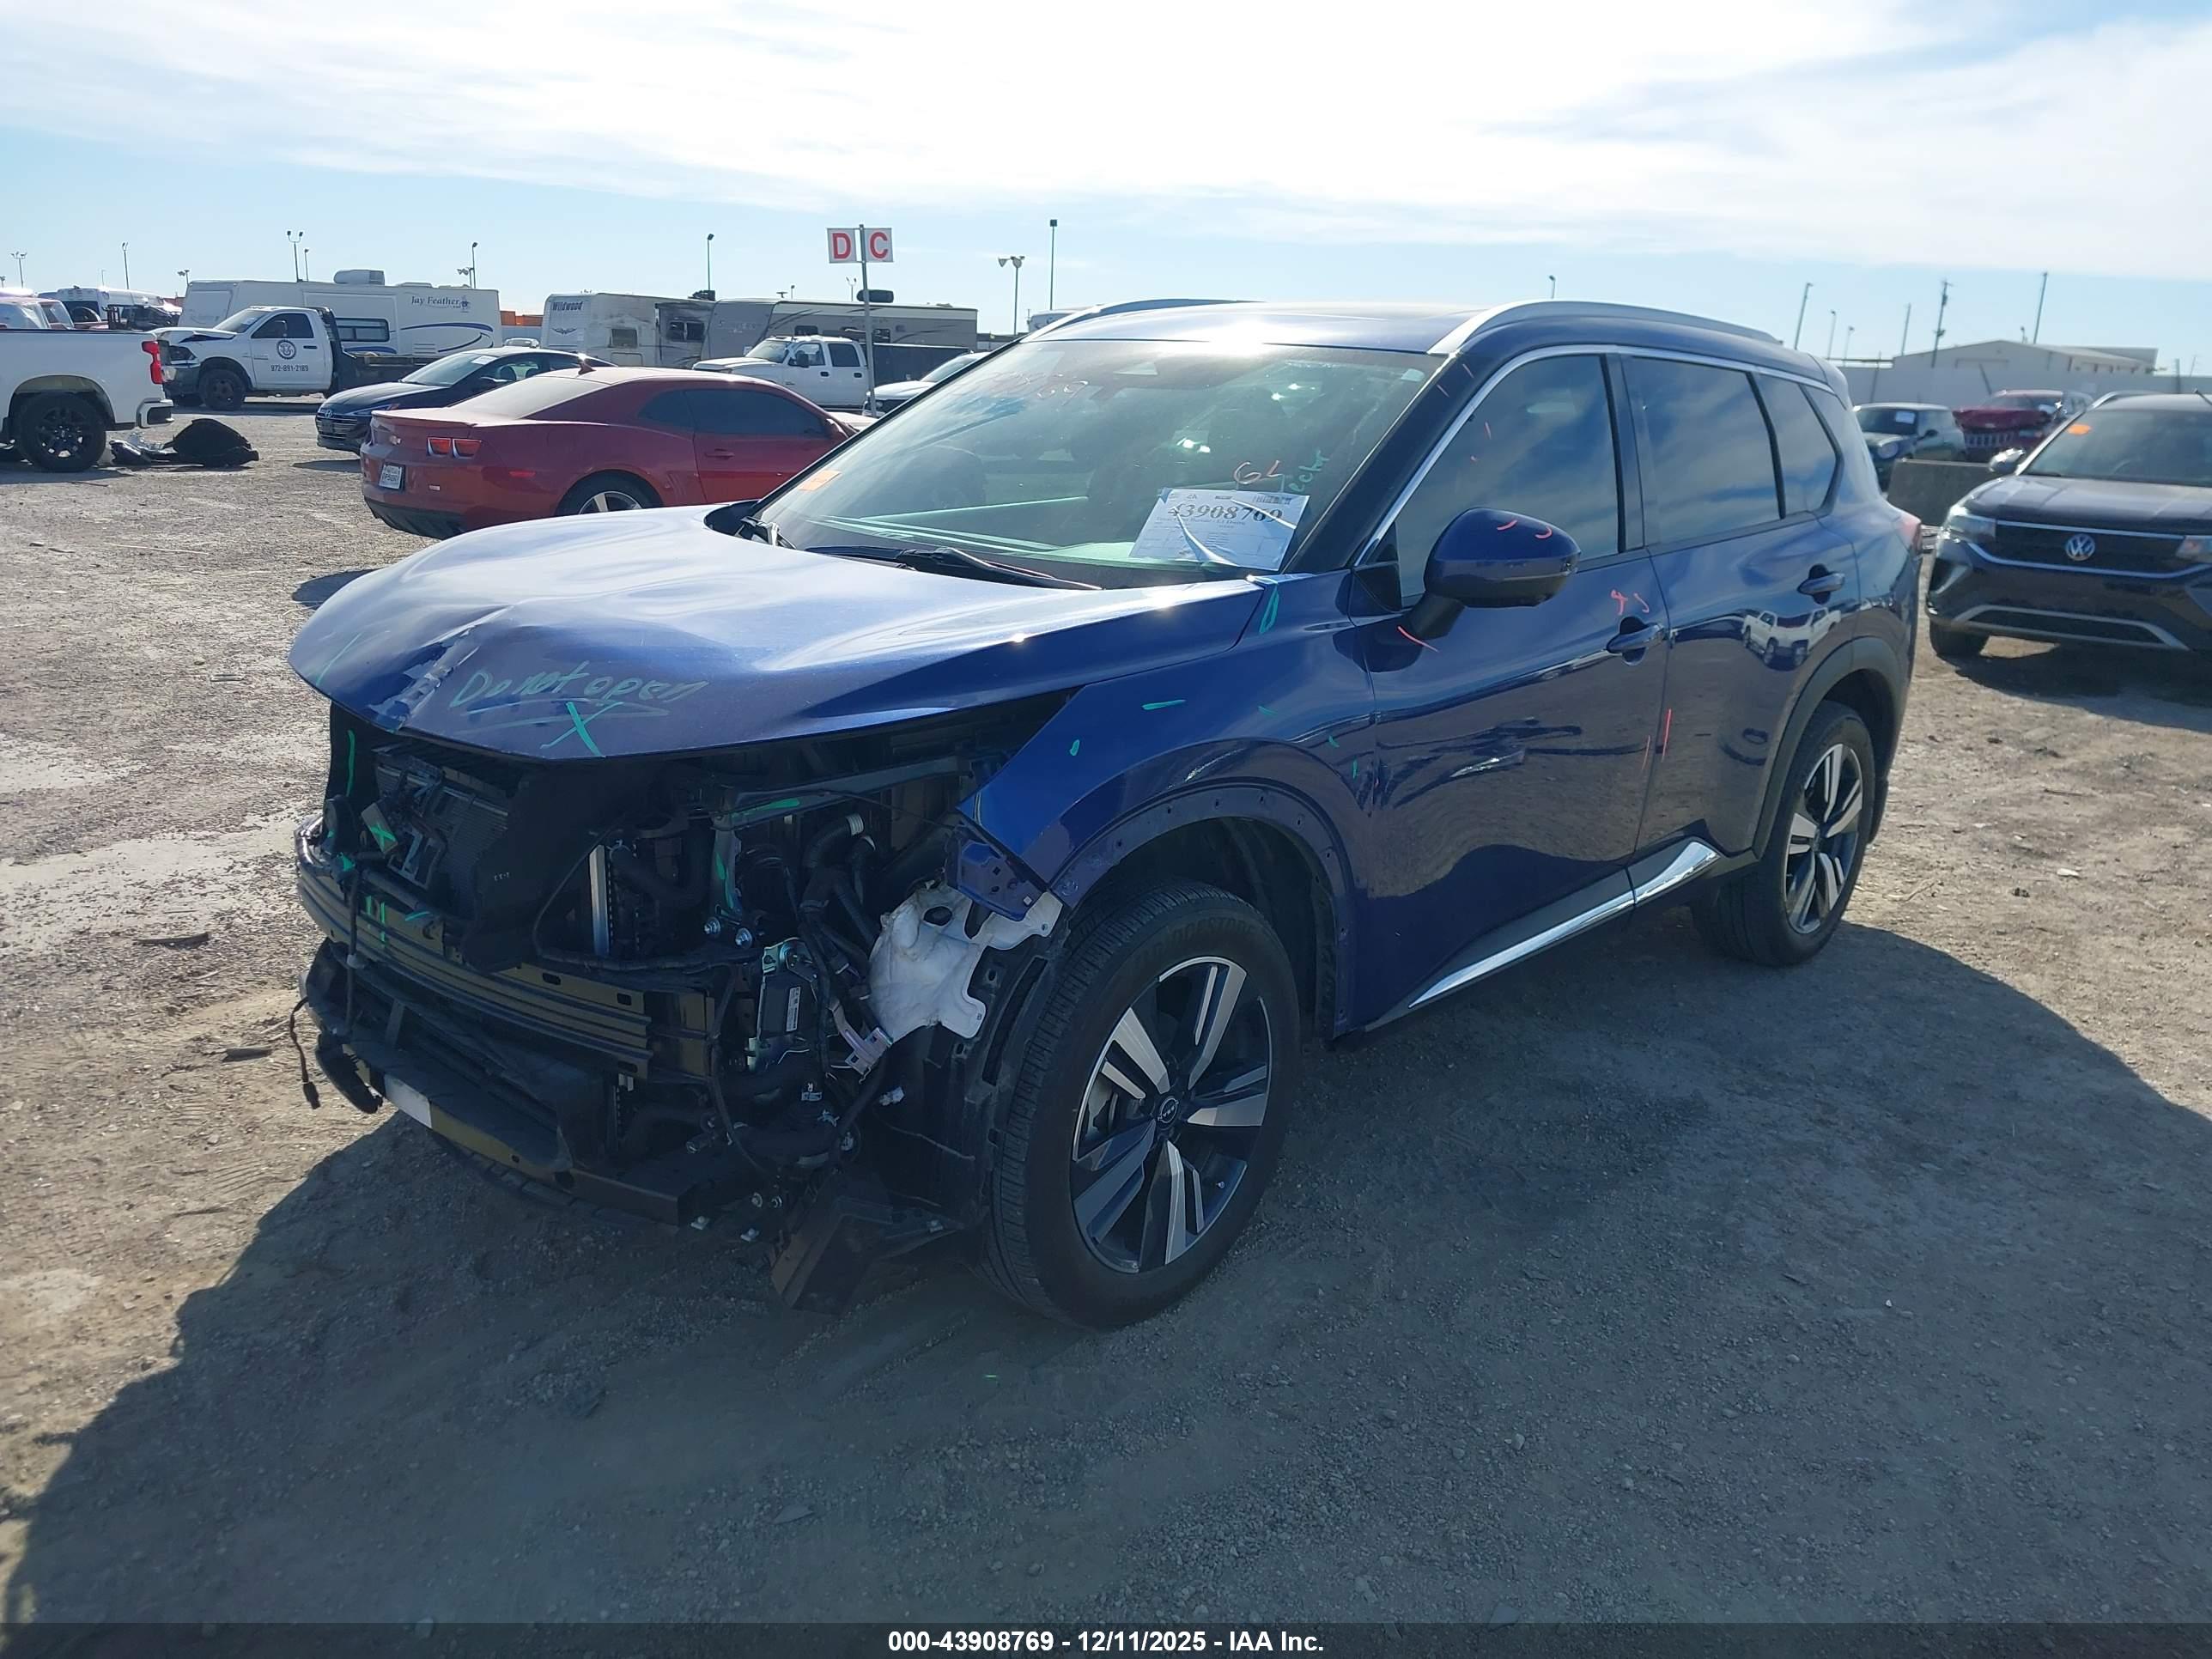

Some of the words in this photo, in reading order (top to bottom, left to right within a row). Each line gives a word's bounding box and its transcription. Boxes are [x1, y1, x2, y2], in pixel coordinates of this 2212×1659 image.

[832, 232, 852, 259] D
[869, 232, 889, 259] C
[411, 295, 425, 306] Jay
[427, 295, 460, 305] Feather
[551, 301, 583, 311] Wildwood
